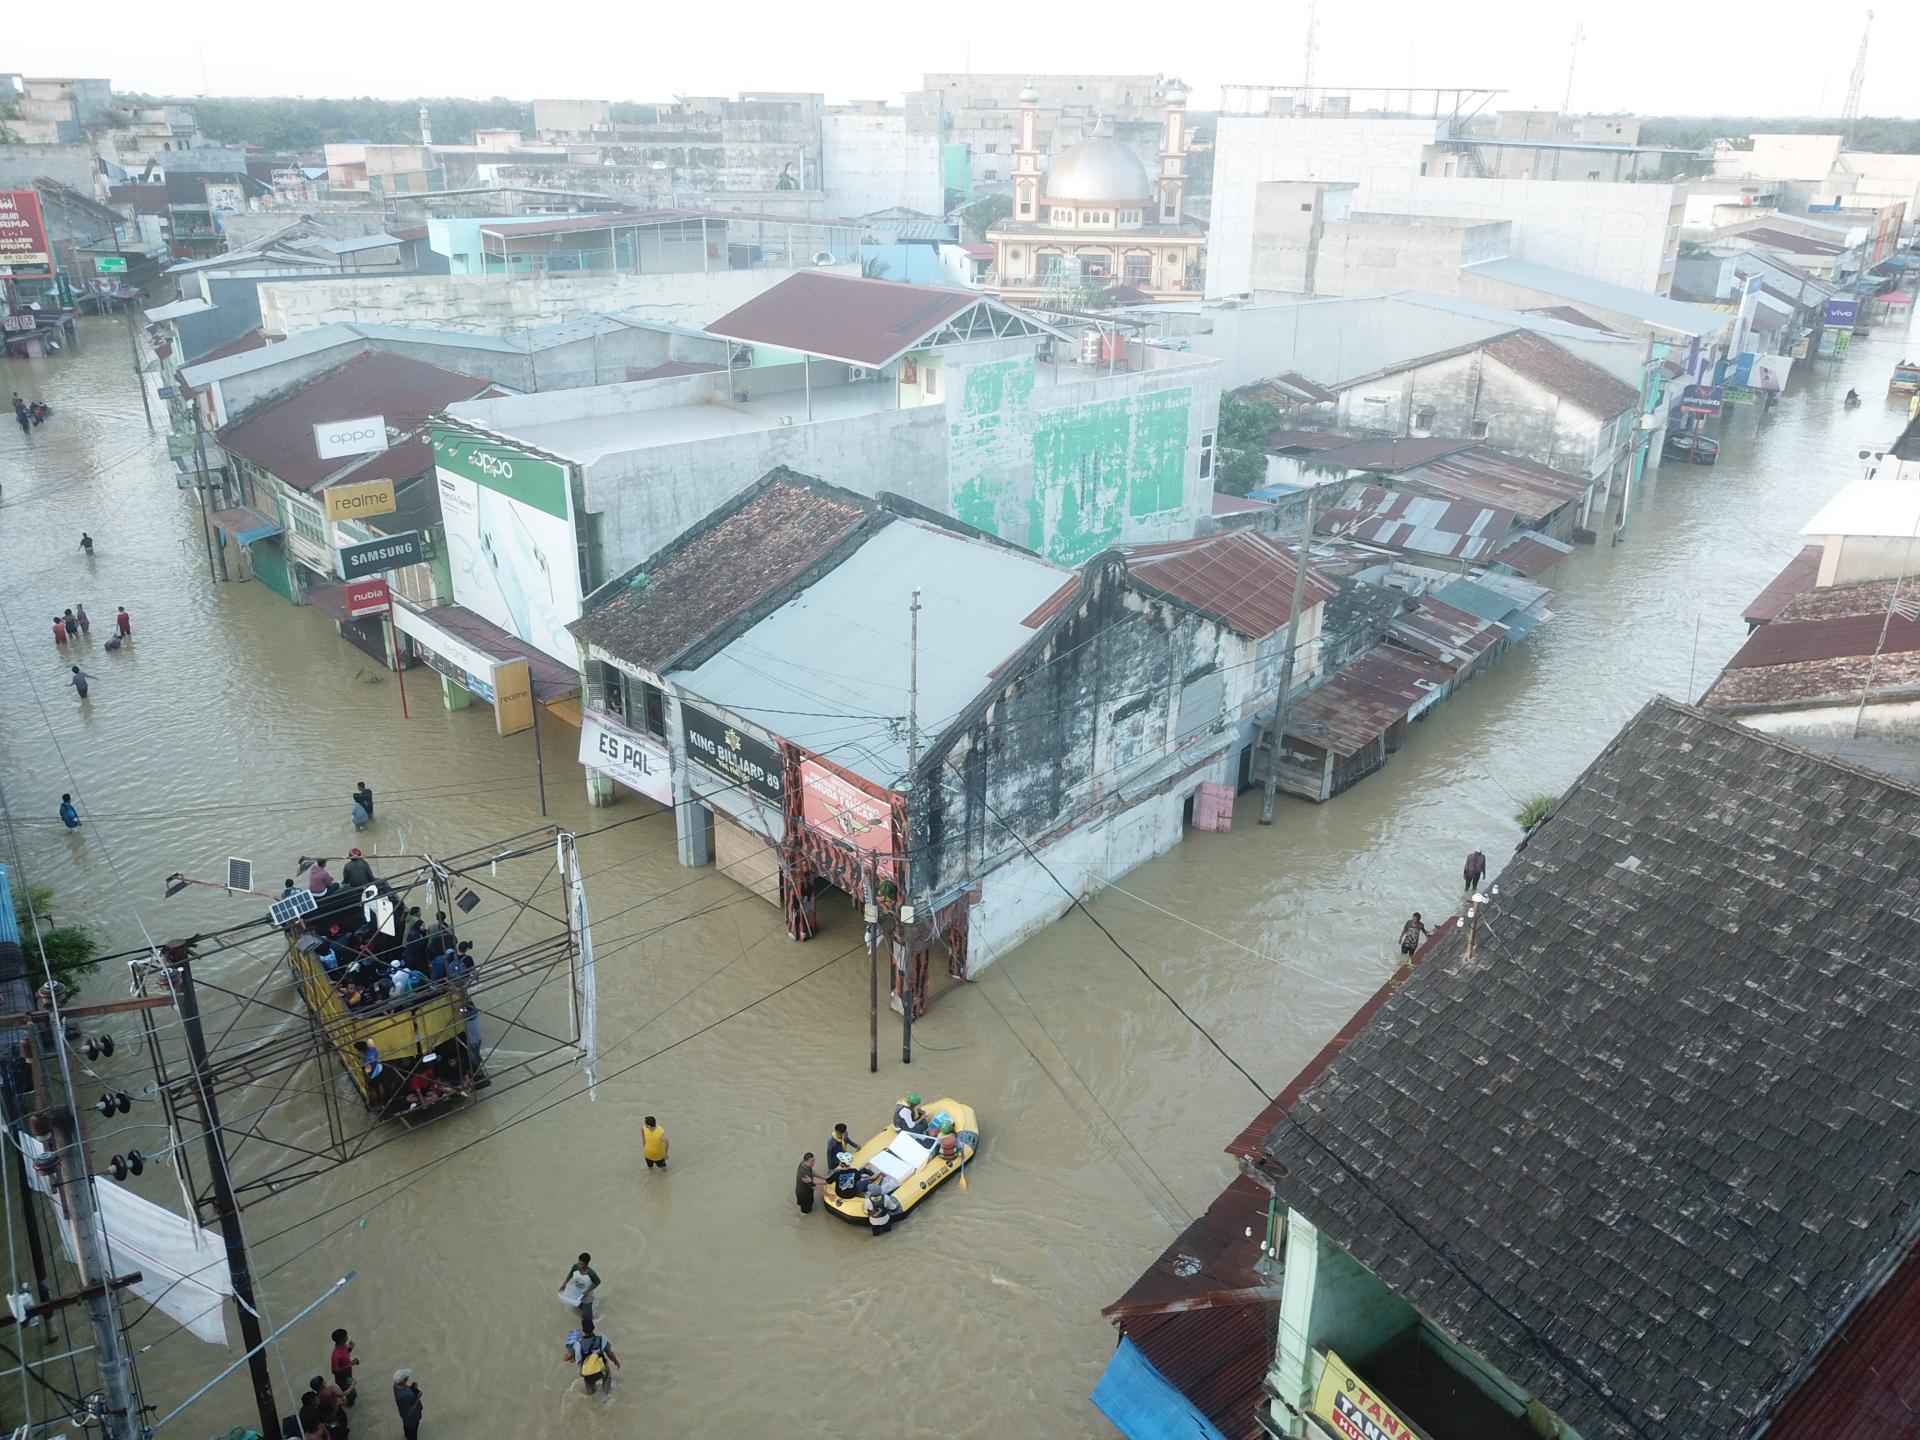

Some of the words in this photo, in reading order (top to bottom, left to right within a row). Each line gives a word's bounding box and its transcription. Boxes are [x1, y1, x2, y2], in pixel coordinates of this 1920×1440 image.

[330, 429, 375, 444] oppo
[473, 449, 513, 479] oppo
[335, 492, 388, 511] realme
[351, 543, 412, 566] SAMSUNG
[353, 589, 383, 602] nubia
[690, 729, 716, 755] KING
[599, 732, 619, 759] ES
[623, 743, 652, 777] PAL
